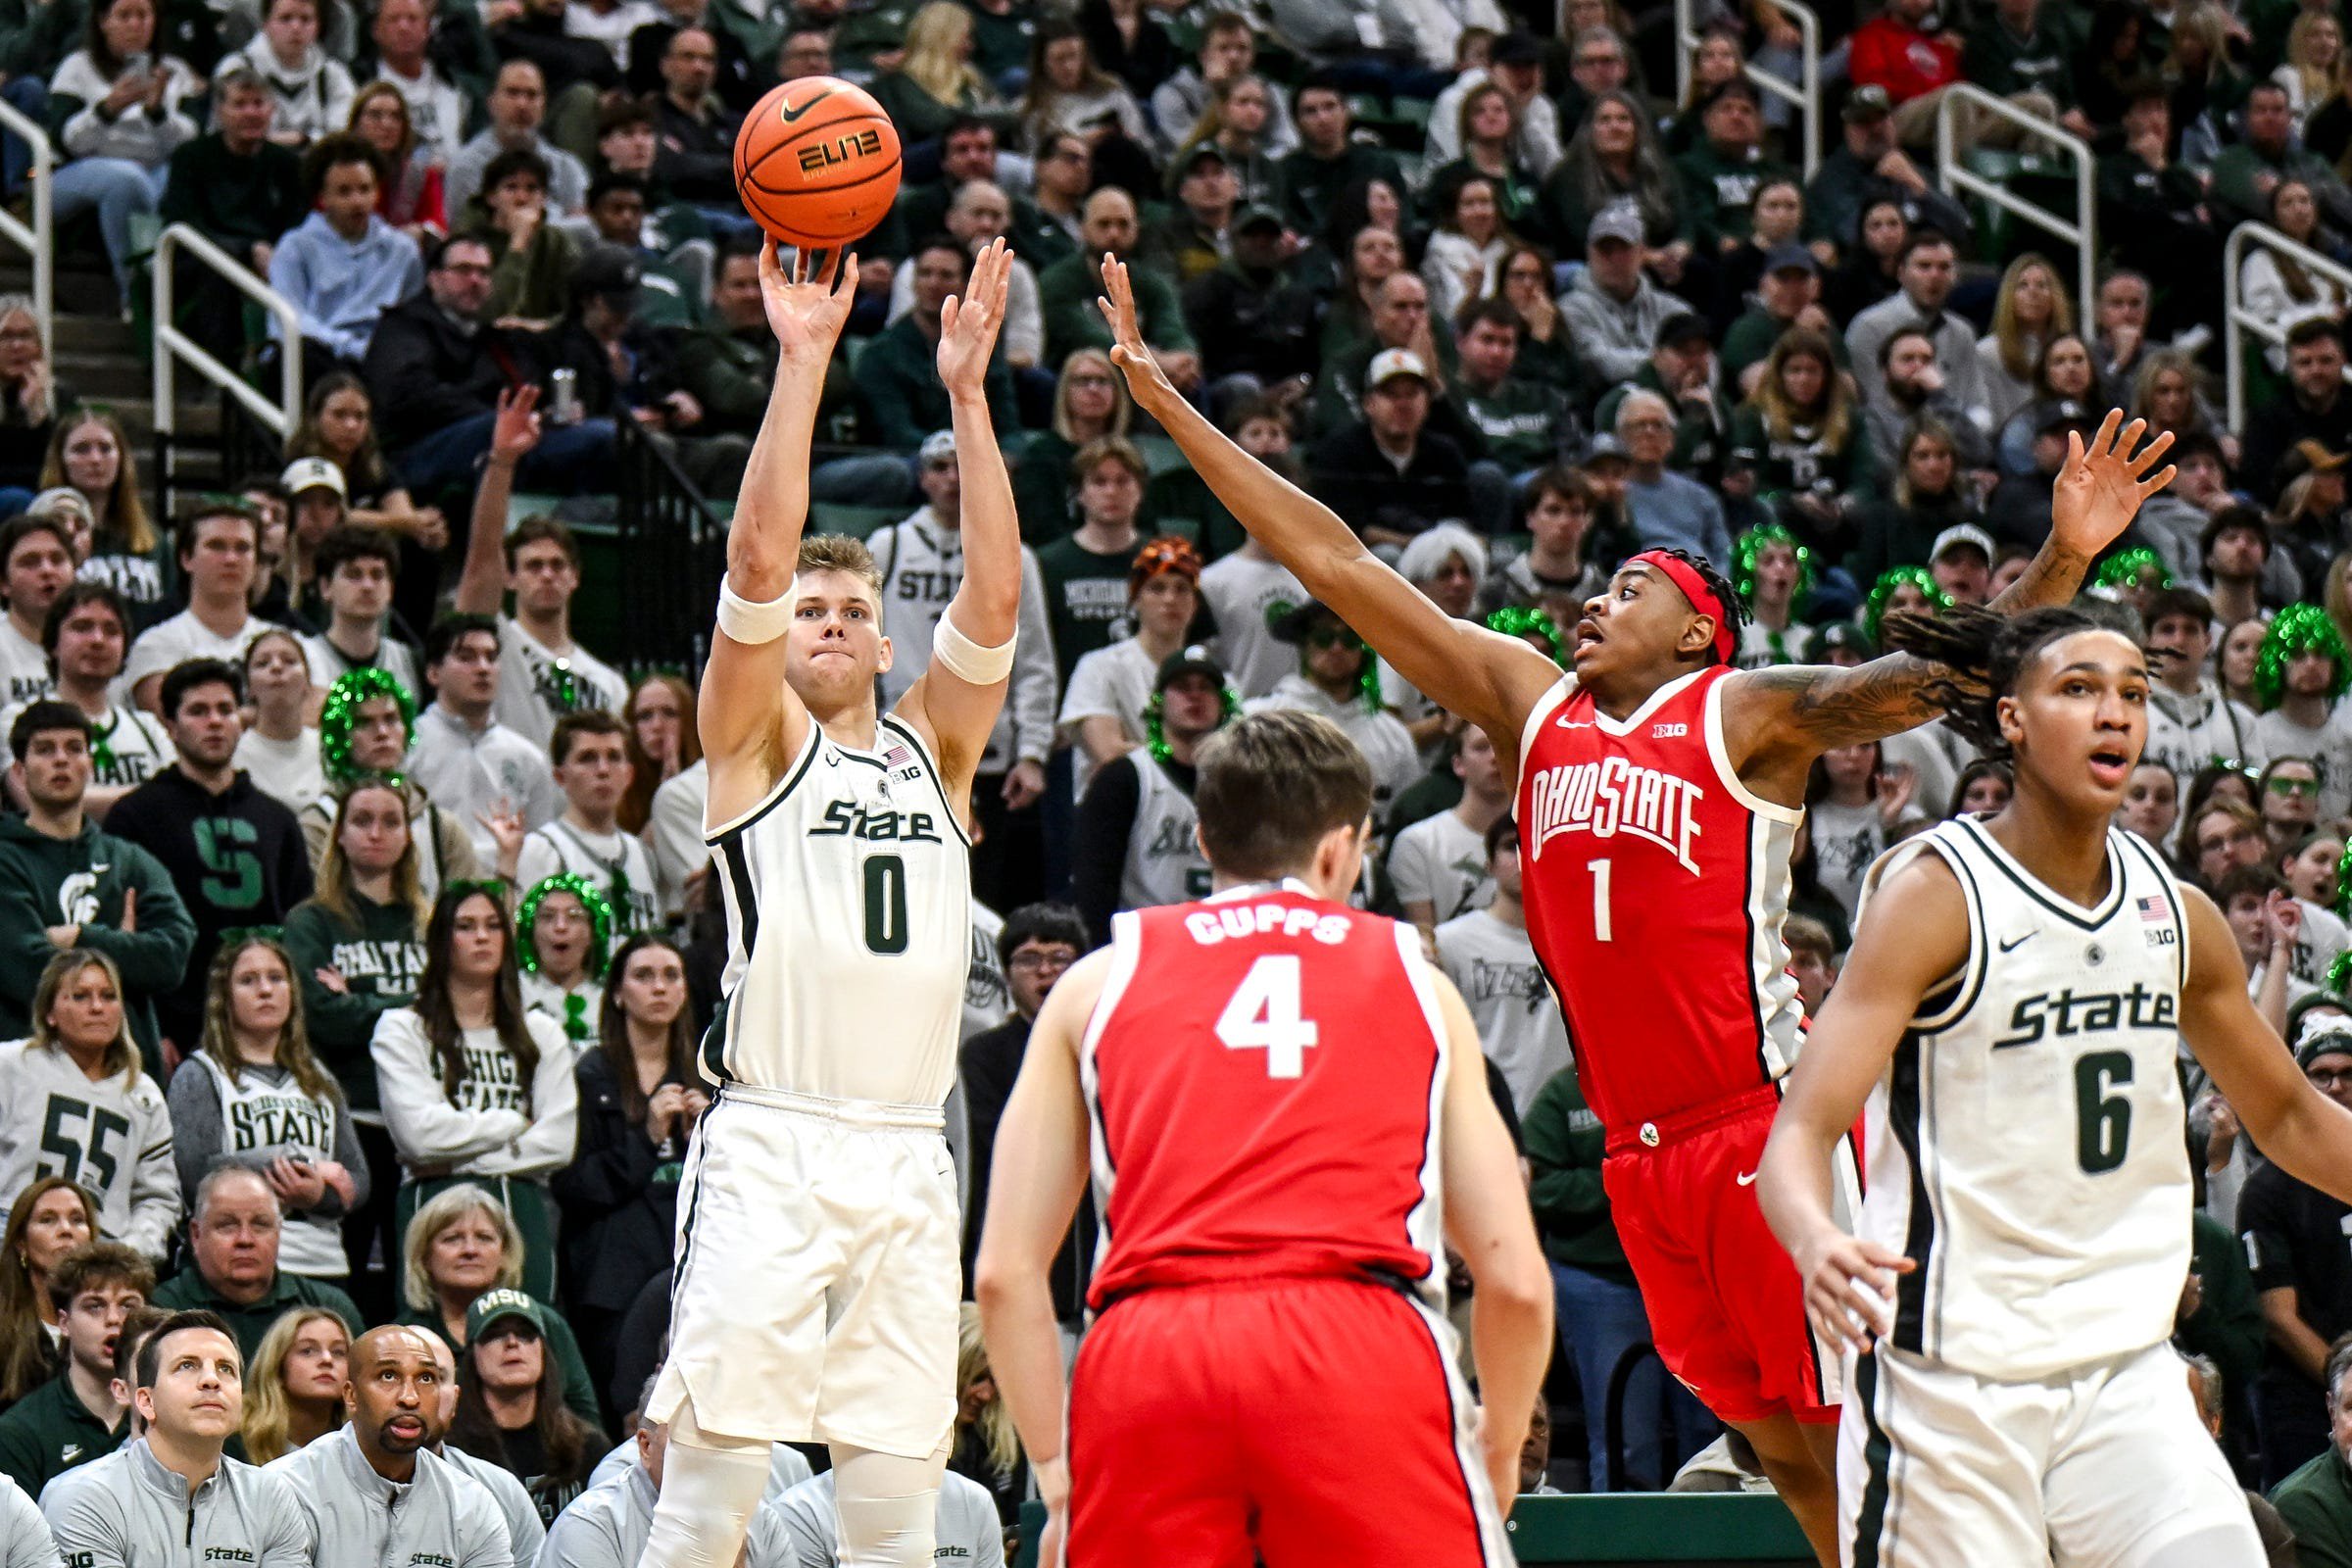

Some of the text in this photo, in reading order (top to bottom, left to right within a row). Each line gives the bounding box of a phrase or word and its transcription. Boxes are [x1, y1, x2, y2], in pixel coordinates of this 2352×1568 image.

[860, 853, 910, 957] 0
[1184, 904, 1352, 946] CUPPS
[1587, 858, 1613, 942] 1
[1213, 954, 1319, 1079] 4
[1990, 982, 2178, 1051] State
[35, 1093, 130, 1191] 55
[230, 1100, 330, 1153] STATE
[2074, 1050, 2133, 1175] 6
[476, 1288, 530, 1316] MSU
[204, 1546, 256, 1563] State
[408, 1551, 455, 1568] State
